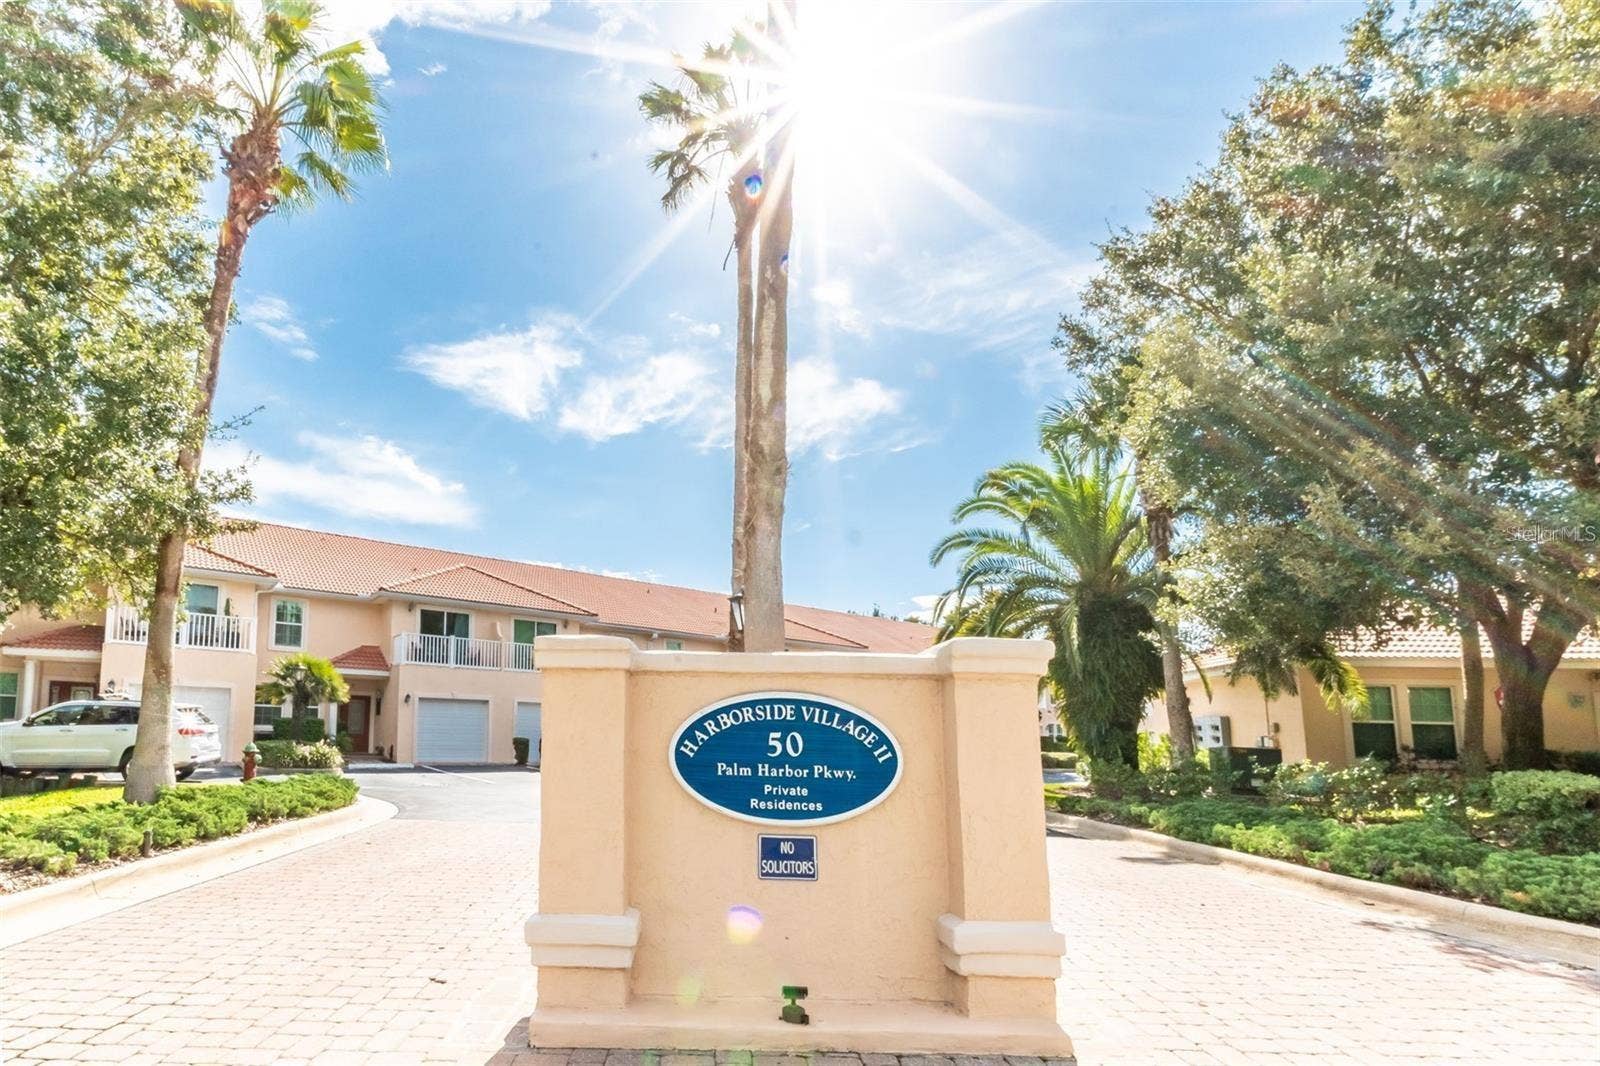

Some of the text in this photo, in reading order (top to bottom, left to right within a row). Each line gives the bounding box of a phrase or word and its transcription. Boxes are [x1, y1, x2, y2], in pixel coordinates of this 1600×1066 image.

[680, 704, 892, 764] HARBORSIDE VILLAGE II
[767, 732, 804, 757] 50
[717, 763, 856, 782] Palm Harbor Pkwy.
[764, 785, 809, 796] Private
[750, 799, 823, 811] Residences
[780, 841, 795, 855] NO
[761, 860, 815, 875] SOLICITORS
